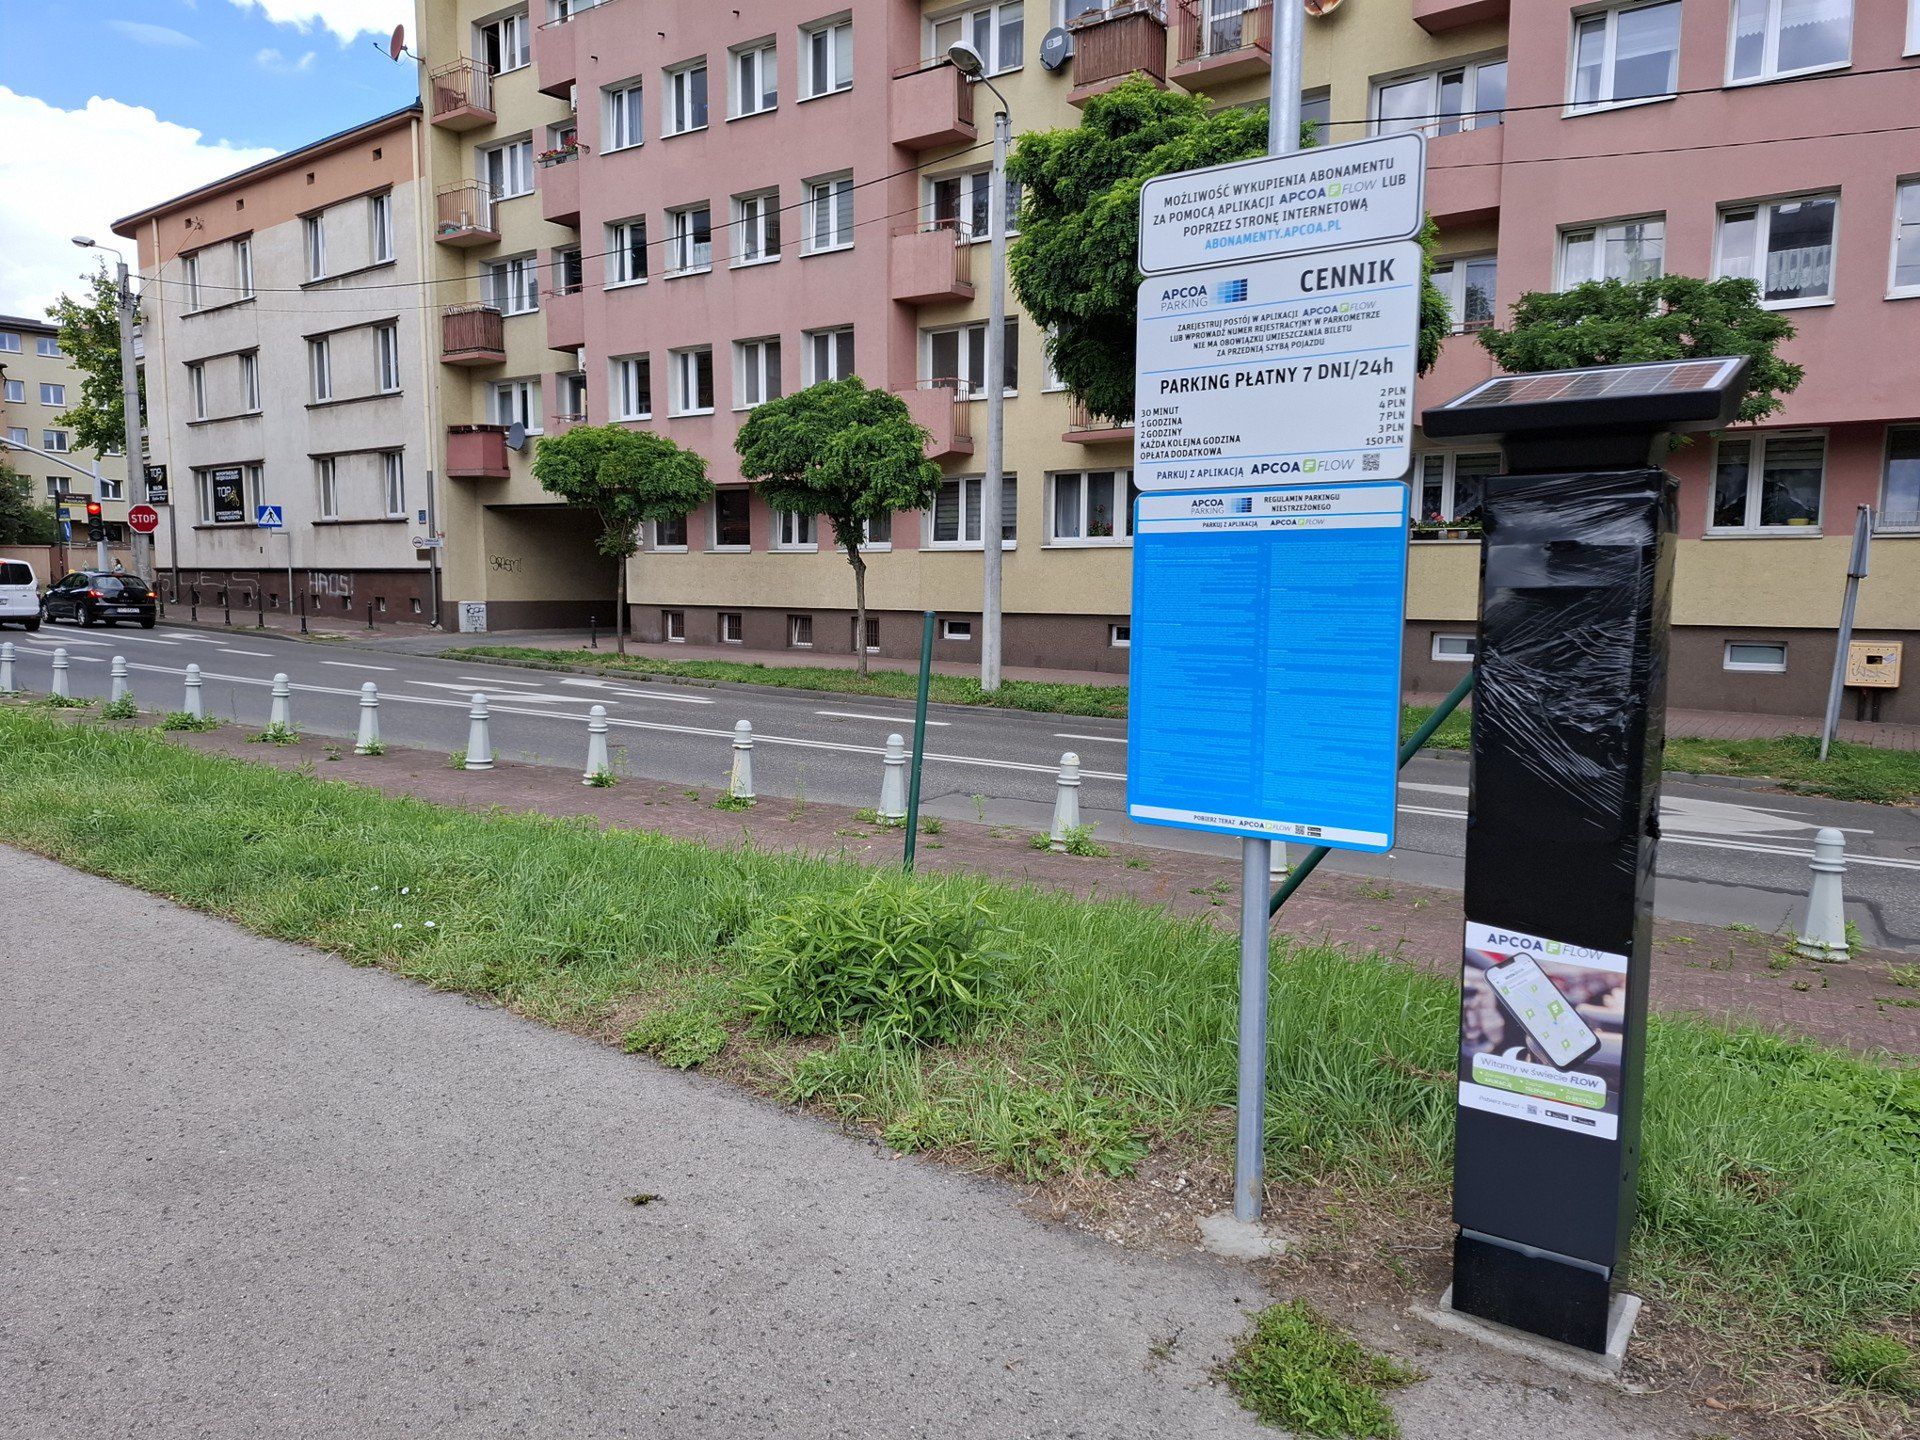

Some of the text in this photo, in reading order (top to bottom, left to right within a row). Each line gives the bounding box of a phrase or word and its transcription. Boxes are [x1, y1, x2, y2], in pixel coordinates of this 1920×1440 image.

[1164, 157, 1394, 207] MOŻLIWOŚĆ WYKUPIENIA ABONAMENTU
[1153, 173, 1406, 225] ZA POMOCĄ APLIKACJI APCOA FLOW LUB
[1184, 198, 1368, 237] POPRZEZ STRONĘ INTERNETOWĄ
[1205, 219, 1341, 250] ABONAMENTY.APCOA.PL
[1300, 258, 1396, 292] CENNIK
[1161, 285, 1207, 301] APCOA
[1161, 296, 1208, 312] PARKING
[1177, 319, 1222, 332] ZAREJESTRUJ
[1224, 315, 1251, 326] POSTÓJ
[1260, 310, 1298, 321] APLIKACJI
[1302, 305, 1338, 316] APCOA
[1350, 300, 1377, 311] FLOW
[1170, 334, 1183, 343] LUB
[1185, 328, 1225, 340] WPROWADŹ
[1227, 325, 1253, 335] NUMER
[1255, 319, 1312, 333] REJESTRACYJNY
[1323, 310, 1381, 324] PARKOMETRZE
[1193, 341, 1206, 349] NIE
[1220, 335, 1264, 346] OBOWIĄZKU
[1266, 328, 1322, 341] UMIESZCZANIA
[1324, 324, 1353, 335] BILETU
[1217, 338, 1325, 357] ZA PRZEDNIĄ SZYBĄ POJAZDU
[1160, 357, 1393, 394] PARKING PŁATNY 7 DNI/24h
[1380, 386, 1406, 397] 2 PLN
[1379, 398, 1405, 409] 4 PLN
[1141, 406, 1179, 418] 30 MINUT
[1379, 410, 1405, 421] 7 PLN
[1141, 417, 1183, 428] 1 GODZINA
[1378, 423, 1404, 433] 3 PLN
[1140, 428, 1183, 439] 2 GODZINY
[1140, 435, 1241, 449] KAŻDA KOLEJNA GODZINA
[1365, 435, 1403, 446] 150 PLN
[1140, 447, 1222, 460] OPŁATA DODATKOWA
[1156, 459, 1355, 480] PARKUJ Z APLIKACJĄ APCOA FLOW
[1191, 498, 1224, 507] APCOA
[1264, 493, 1340, 503] REGULAMIN PARKINGU
[1190, 506, 1225, 515] PARKING
[1271, 502, 1332, 512] NIESTRZEŻONEGO
[131, 514, 156, 524] STOP
[1270, 518, 1297, 526] APCOA
[1239, 820, 1265, 829] APCOA
[1487, 933, 1604, 960] APCOA FLOW
[1481, 1057, 1518, 1074] Witamy
[1570, 1075, 1600, 1088] FLOW
